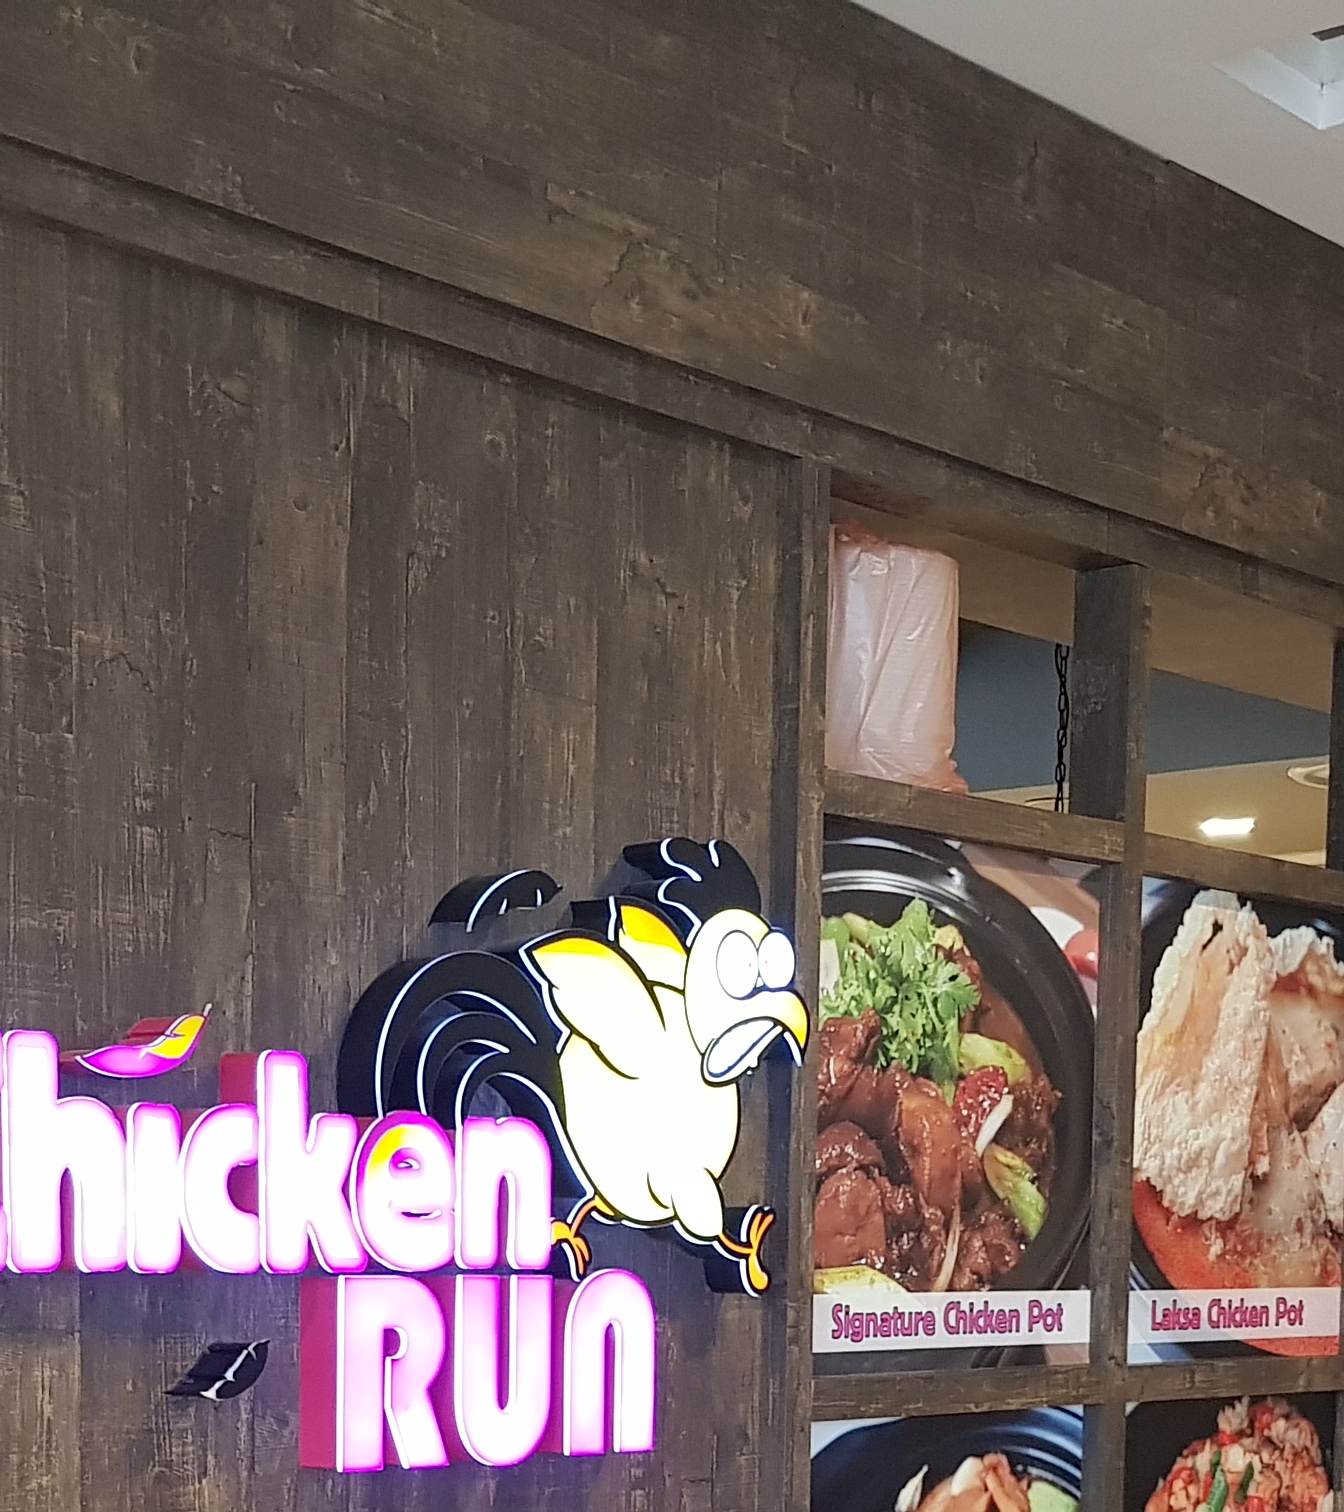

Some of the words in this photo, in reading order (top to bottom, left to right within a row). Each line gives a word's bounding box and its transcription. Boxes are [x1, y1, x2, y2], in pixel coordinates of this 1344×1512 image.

[831, 1302, 937, 1343] Signature
[943, 1299, 1021, 1335] Chicken
[1027, 1299, 1064, 1333] Pot
[1150, 1299, 1202, 1332] Laksa
[1207, 1297, 1270, 1329] Chicken
[1274, 1296, 1305, 1327] Pot
